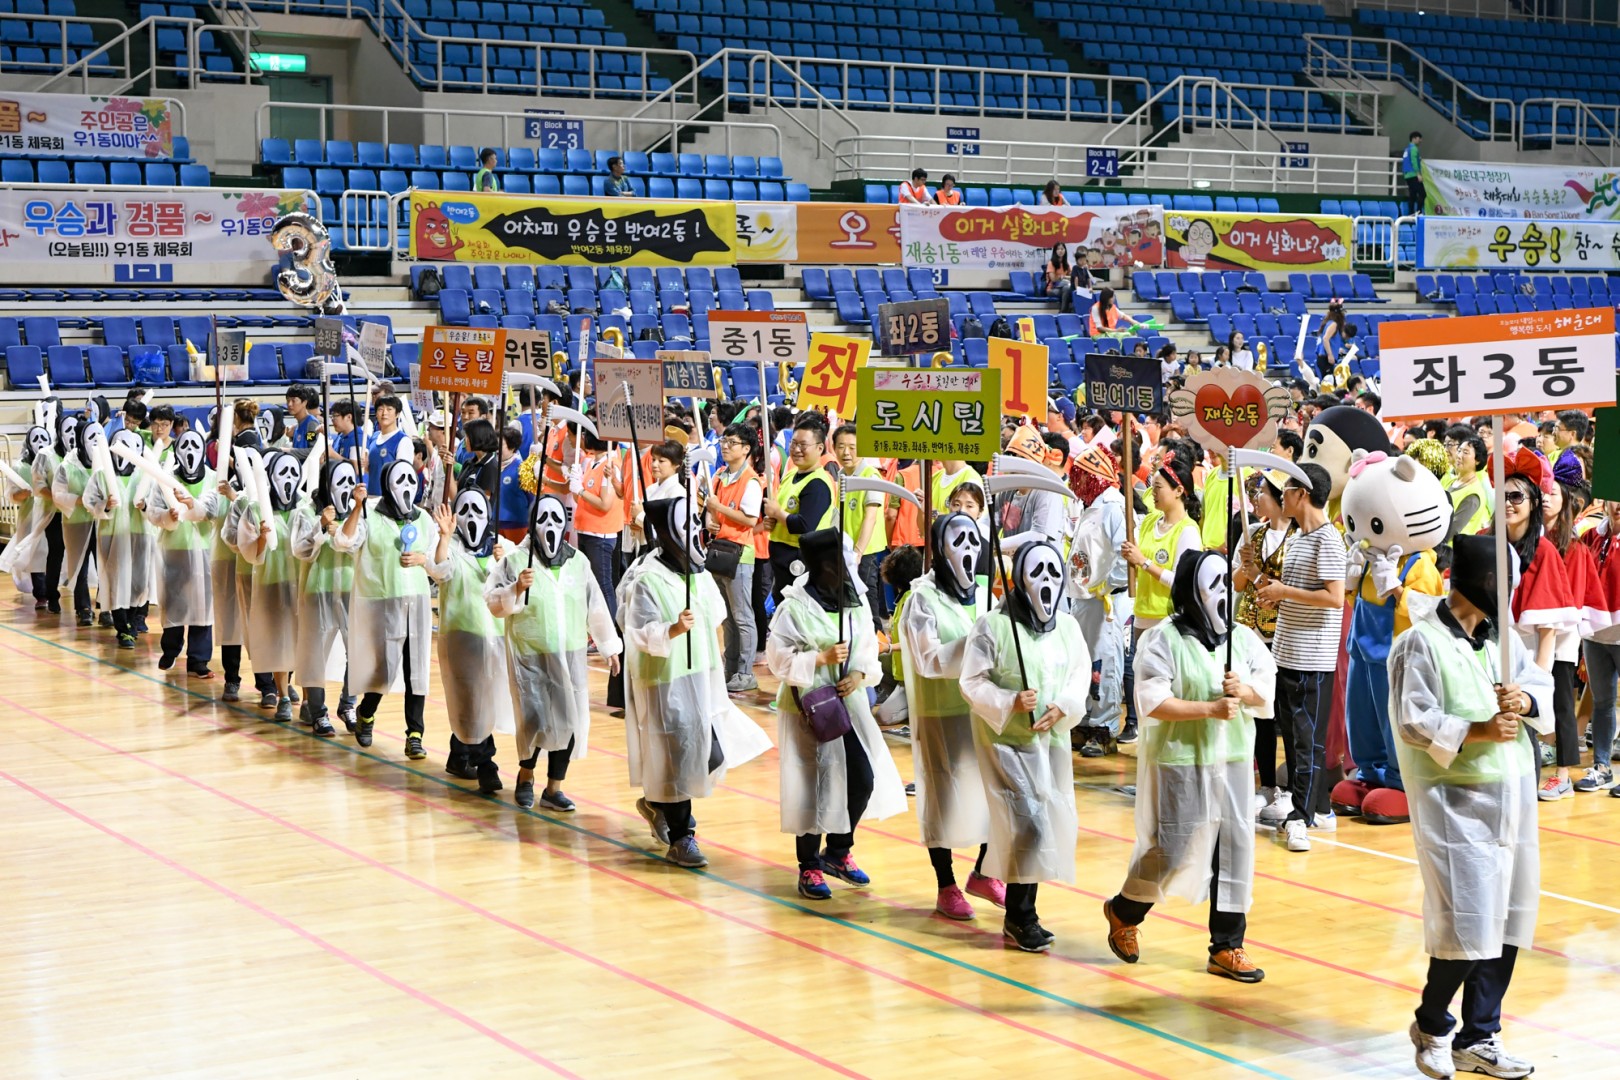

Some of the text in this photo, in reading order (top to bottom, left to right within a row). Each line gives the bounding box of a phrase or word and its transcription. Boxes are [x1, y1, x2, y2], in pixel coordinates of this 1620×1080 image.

[80, 110, 148, 132] 주인공은
[544, 121, 563, 129] Block
[949, 128, 964, 136] Block
[27, 135, 65, 150] 체육회
[548, 132, 578, 150] 2-3
[1088, 149, 1104, 157] Block
[1091, 160, 1114, 176] 2-4
[24, 200, 117, 237] 우승과
[124, 200, 187, 237] 경품
[503, 214, 559, 237] 어차피
[567, 218, 618, 244] 우승은
[624, 218, 687, 243] 반여2동
[955, 212, 1069, 241] 이거 실화냐?
[48, 241, 193, 258] (오늘팀!!) 우1동 체육회
[570, 244, 604, 255] 반여2동
[1229, 228, 1320, 256] 이거 실화냐?
[1488, 222, 1562, 267] 우승!
[888, 310, 939, 346] 좌2동
[1535, 323, 1552, 333] 도시
[1554, 313, 1602, 331] 해운대
[317, 328, 339, 350] 송정동
[721, 326, 797, 358] 중1동
[216, 344, 240, 362] 3동
[504, 338, 549, 371] 우1동
[665, 363, 709, 389] 재송1동
[901, 373, 931, 389] 우승!
[1412, 346, 1585, 404] 좌3동
[1091, 381, 1154, 411] 반여1동
[871, 399, 985, 436] 도시팀
[1203, 402, 1259, 428] 재송2동
[958, 442, 980, 455] 재송2동
